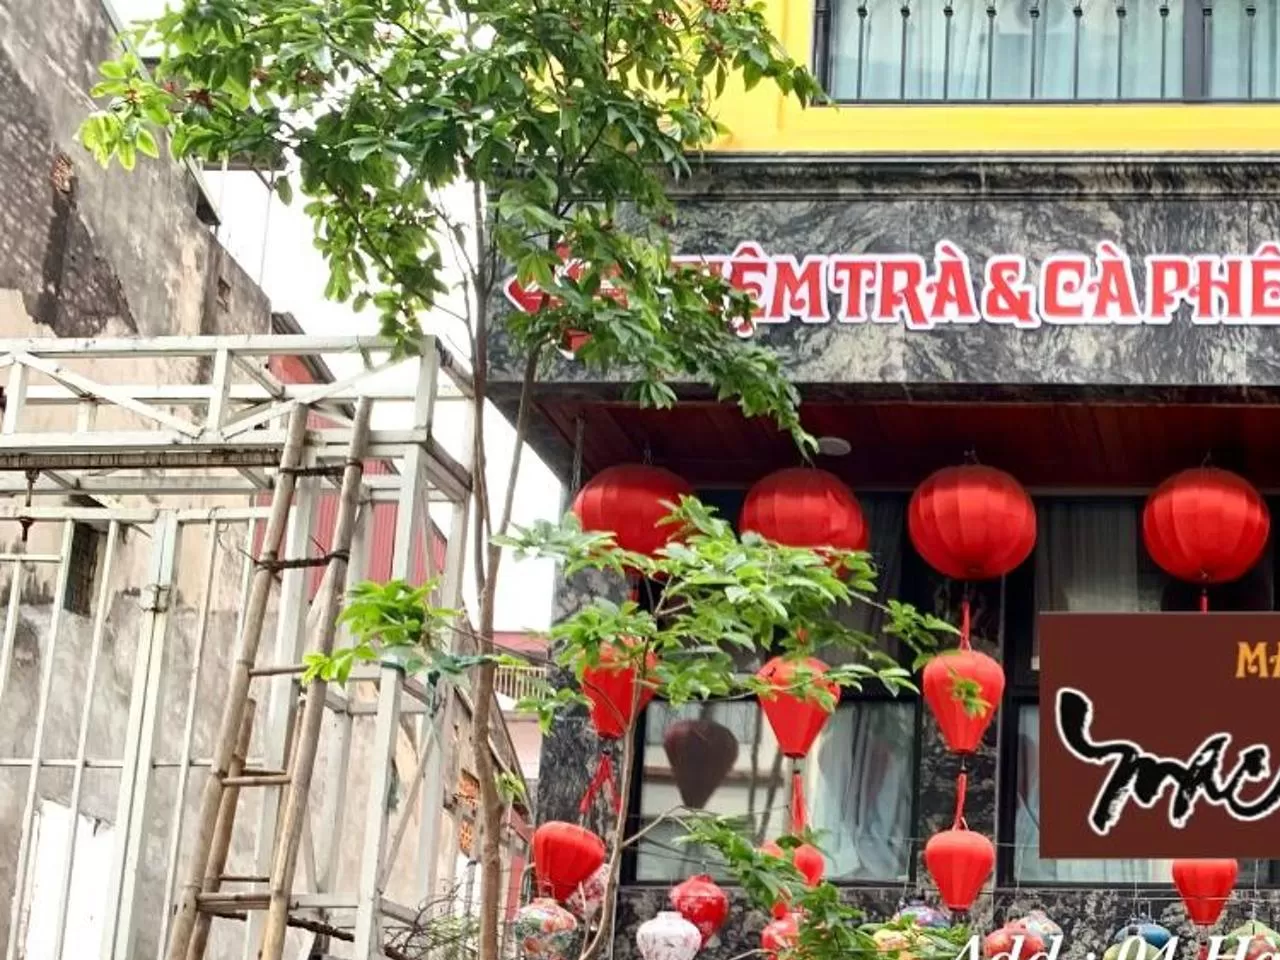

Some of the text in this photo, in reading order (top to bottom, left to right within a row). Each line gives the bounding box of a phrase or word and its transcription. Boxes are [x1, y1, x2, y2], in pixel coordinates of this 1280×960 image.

[833, 243, 977, 324] TRÀ
[983, 259, 1035, 323] &
[1043, 243, 1138, 319] CÀ
